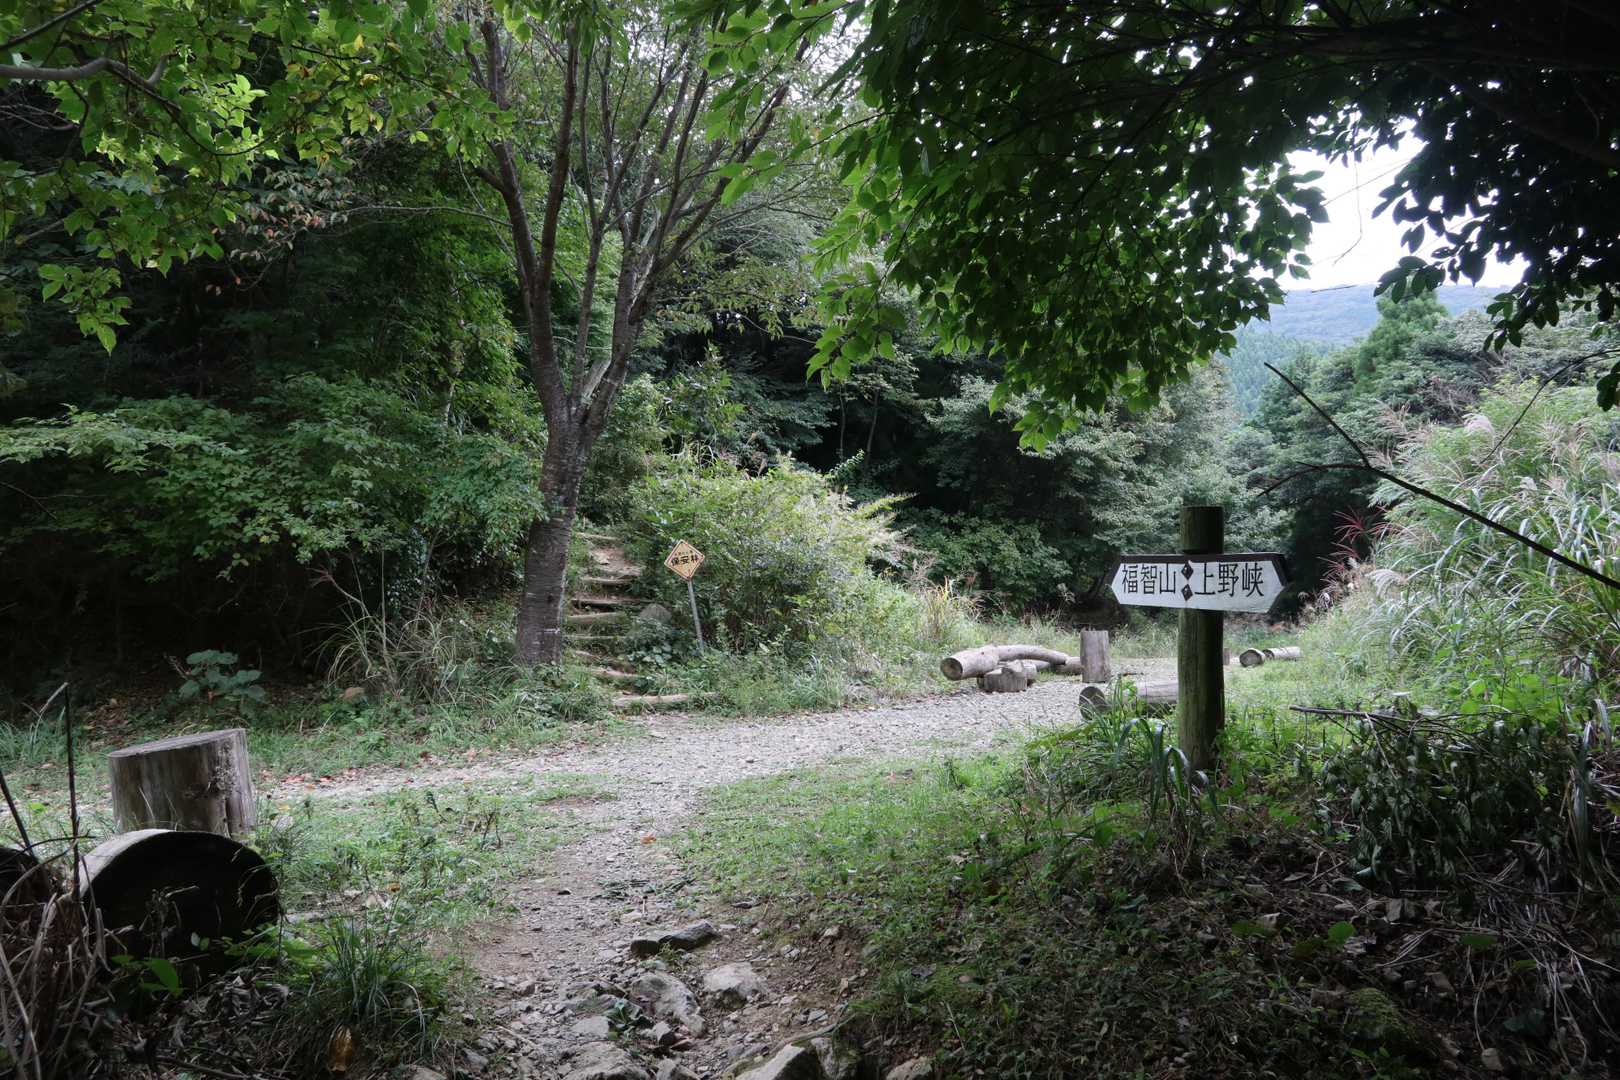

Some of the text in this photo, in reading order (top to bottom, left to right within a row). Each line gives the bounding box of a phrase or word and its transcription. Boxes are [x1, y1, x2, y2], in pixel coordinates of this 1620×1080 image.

[1121, 563, 1176, 595] 福智山
[1194, 562, 1264, 598] 上野峡
